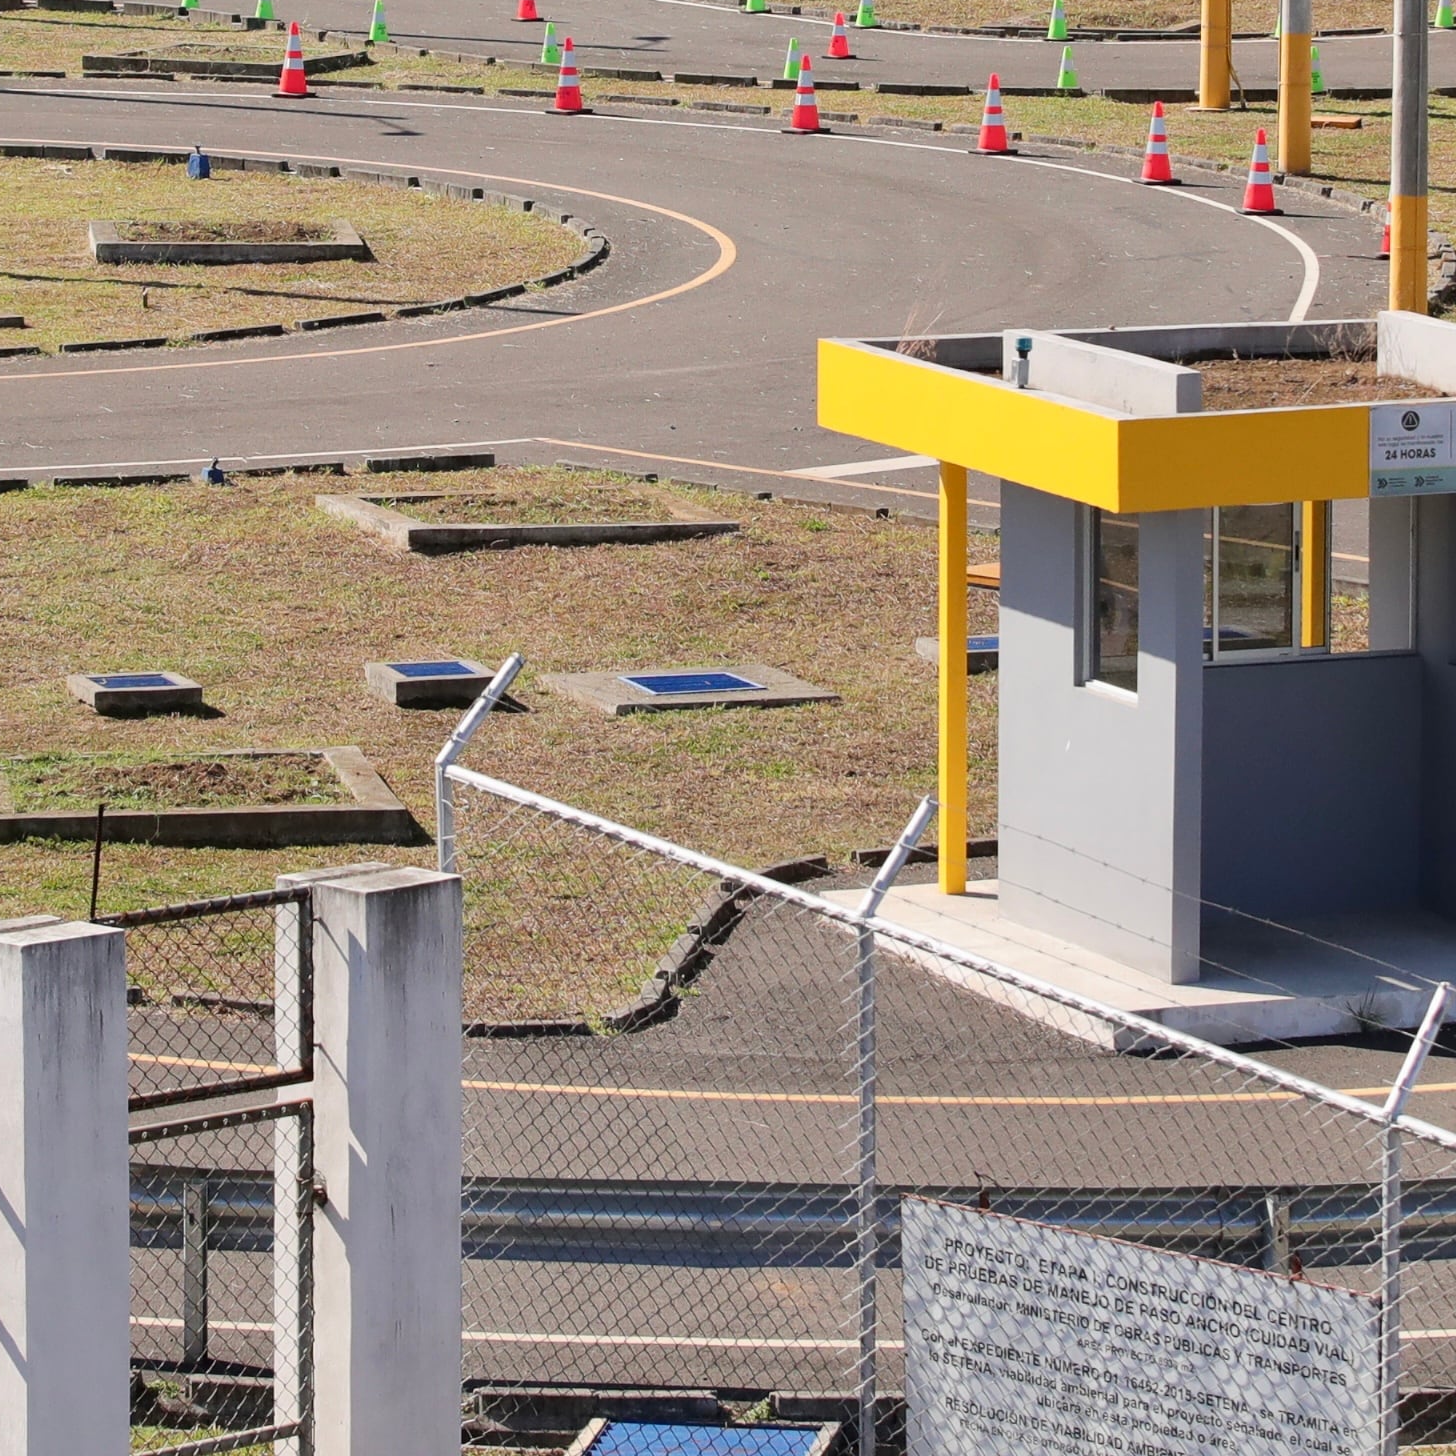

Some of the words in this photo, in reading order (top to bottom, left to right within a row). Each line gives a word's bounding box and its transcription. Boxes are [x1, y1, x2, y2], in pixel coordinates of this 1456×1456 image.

[1384, 450, 1398, 461] 24
[1400, 448, 1437, 460] HORAS
[924, 1255, 943, 1273] DE
[948, 1260, 1018, 1290] PRUEBAS
[1022, 1277, 1043, 1295] DE
[1047, 1282, 1109, 1310] MANEJO
[1114, 1297, 1134, 1316] DE
[1139, 1303, 1180, 1326] PASO
[1185, 1313, 1241, 1339] ANCHO
[1244, 1326, 1309, 1355] (CUIDAD
[1314, 1341, 1356, 1366] VIAL)
[1038, 1257, 1088, 1282] ETAPA
[1105, 1272, 1228, 1313] CONSTRUCCIÓN
[1232, 1300, 1262, 1321] DEL
[1266, 1308, 1332, 1336] CENTRO
[920, 1326, 944, 1345] Con
[961, 1337, 1040, 1367] EXPEDIENTE
[1259, 1407, 1274, 1421] se
[1277, 1409, 1339, 1436] TRAMITA
[1342, 1425, 1358, 1440] en
[1015, 1300, 1089, 1330] MINISTERIO
[1093, 1318, 1112, 1335] DE
[1113, 1322, 1160, 1346] OBRAS
[1233, 1349, 1243, 1365] Y
[1246, 1352, 1347, 1387] TRANSPORTES
[998, 1365, 1057, 1390] viabilidad
[1060, 1379, 1118, 1405] ambiental
[1122, 1394, 1150, 1413] para
[1166, 1404, 1223, 1430] proyecto
[1288, 1431, 1301, 1447] el
[1305, 1435, 1332, 1454] cual
[1335, 1444, 1351, 1456] se
[1030, 1416, 1048, 1433] DE
[1051, 1421, 1123, 1450] VIABILIDAD
[1101, 1409, 1128, 1427] esta
[1131, 1416, 1193, 1443] propiedad
[1197, 1432, 1206, 1444] o
